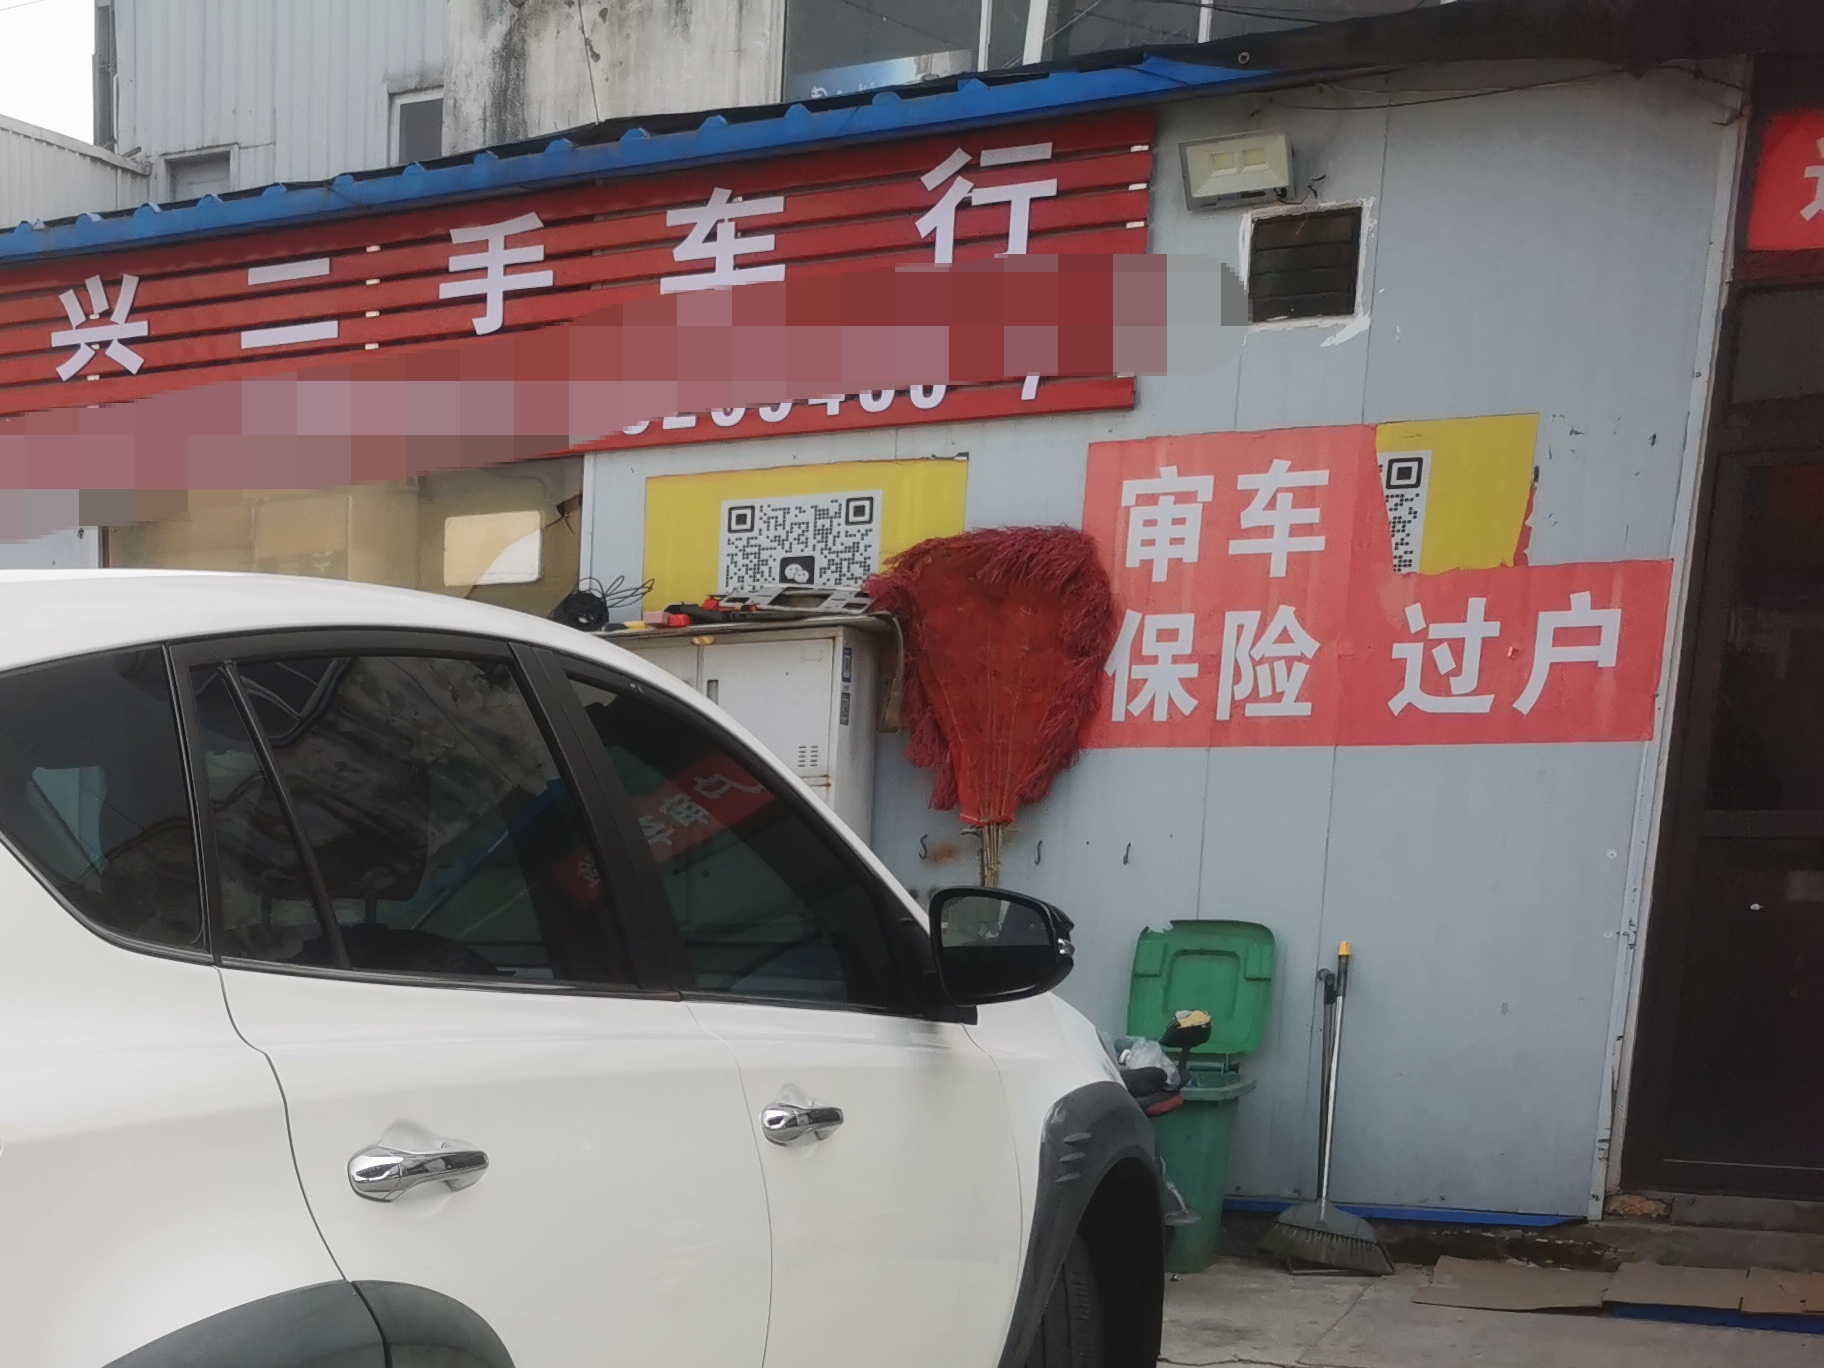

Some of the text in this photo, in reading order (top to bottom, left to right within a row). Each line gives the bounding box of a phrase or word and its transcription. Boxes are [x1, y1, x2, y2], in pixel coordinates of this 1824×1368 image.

[1120, 459, 1330, 583] 审车
[1104, 591, 1623, 722] 保险 过户
